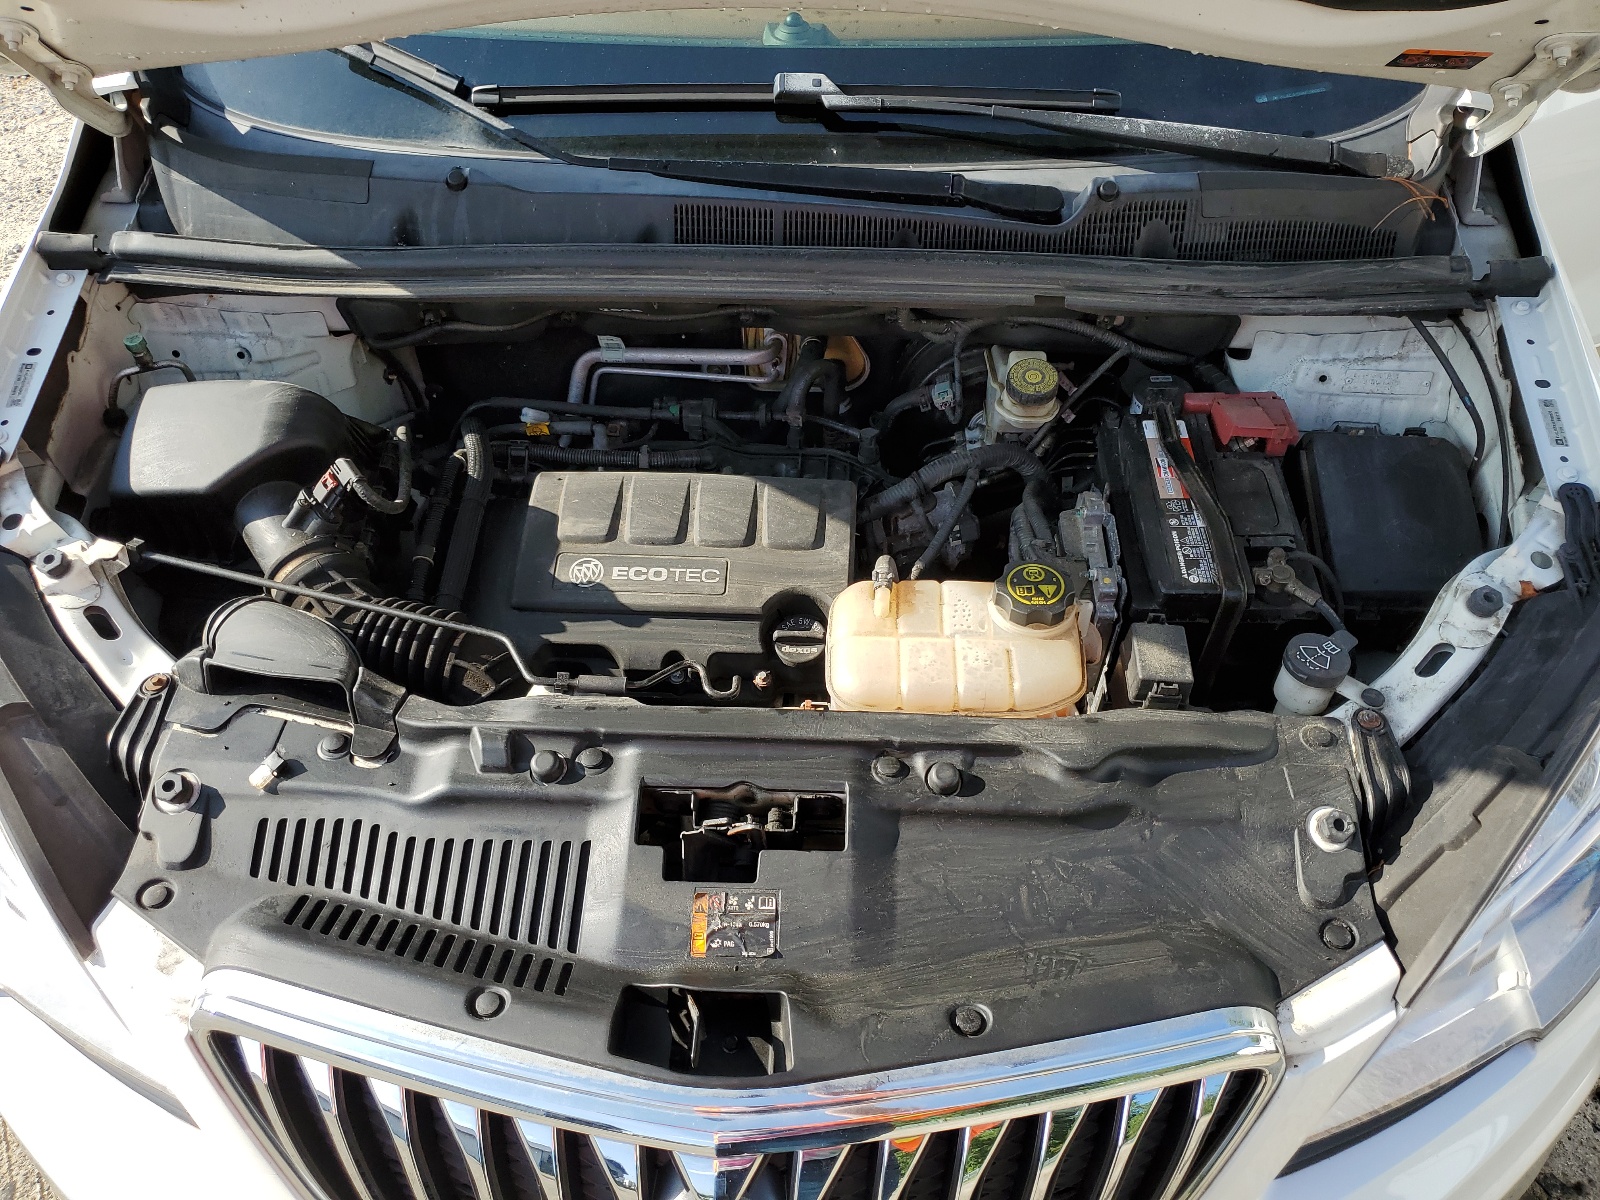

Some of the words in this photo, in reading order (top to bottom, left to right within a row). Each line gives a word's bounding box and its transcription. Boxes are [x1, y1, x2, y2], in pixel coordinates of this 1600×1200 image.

[1172, 530, 1181, 551] POISON
[1177, 550, 1187, 574] DANGER
[611, 566, 720, 583] ECOTEC
[781, 619, 796, 631] SAE
[781, 645, 818, 654] dexos
